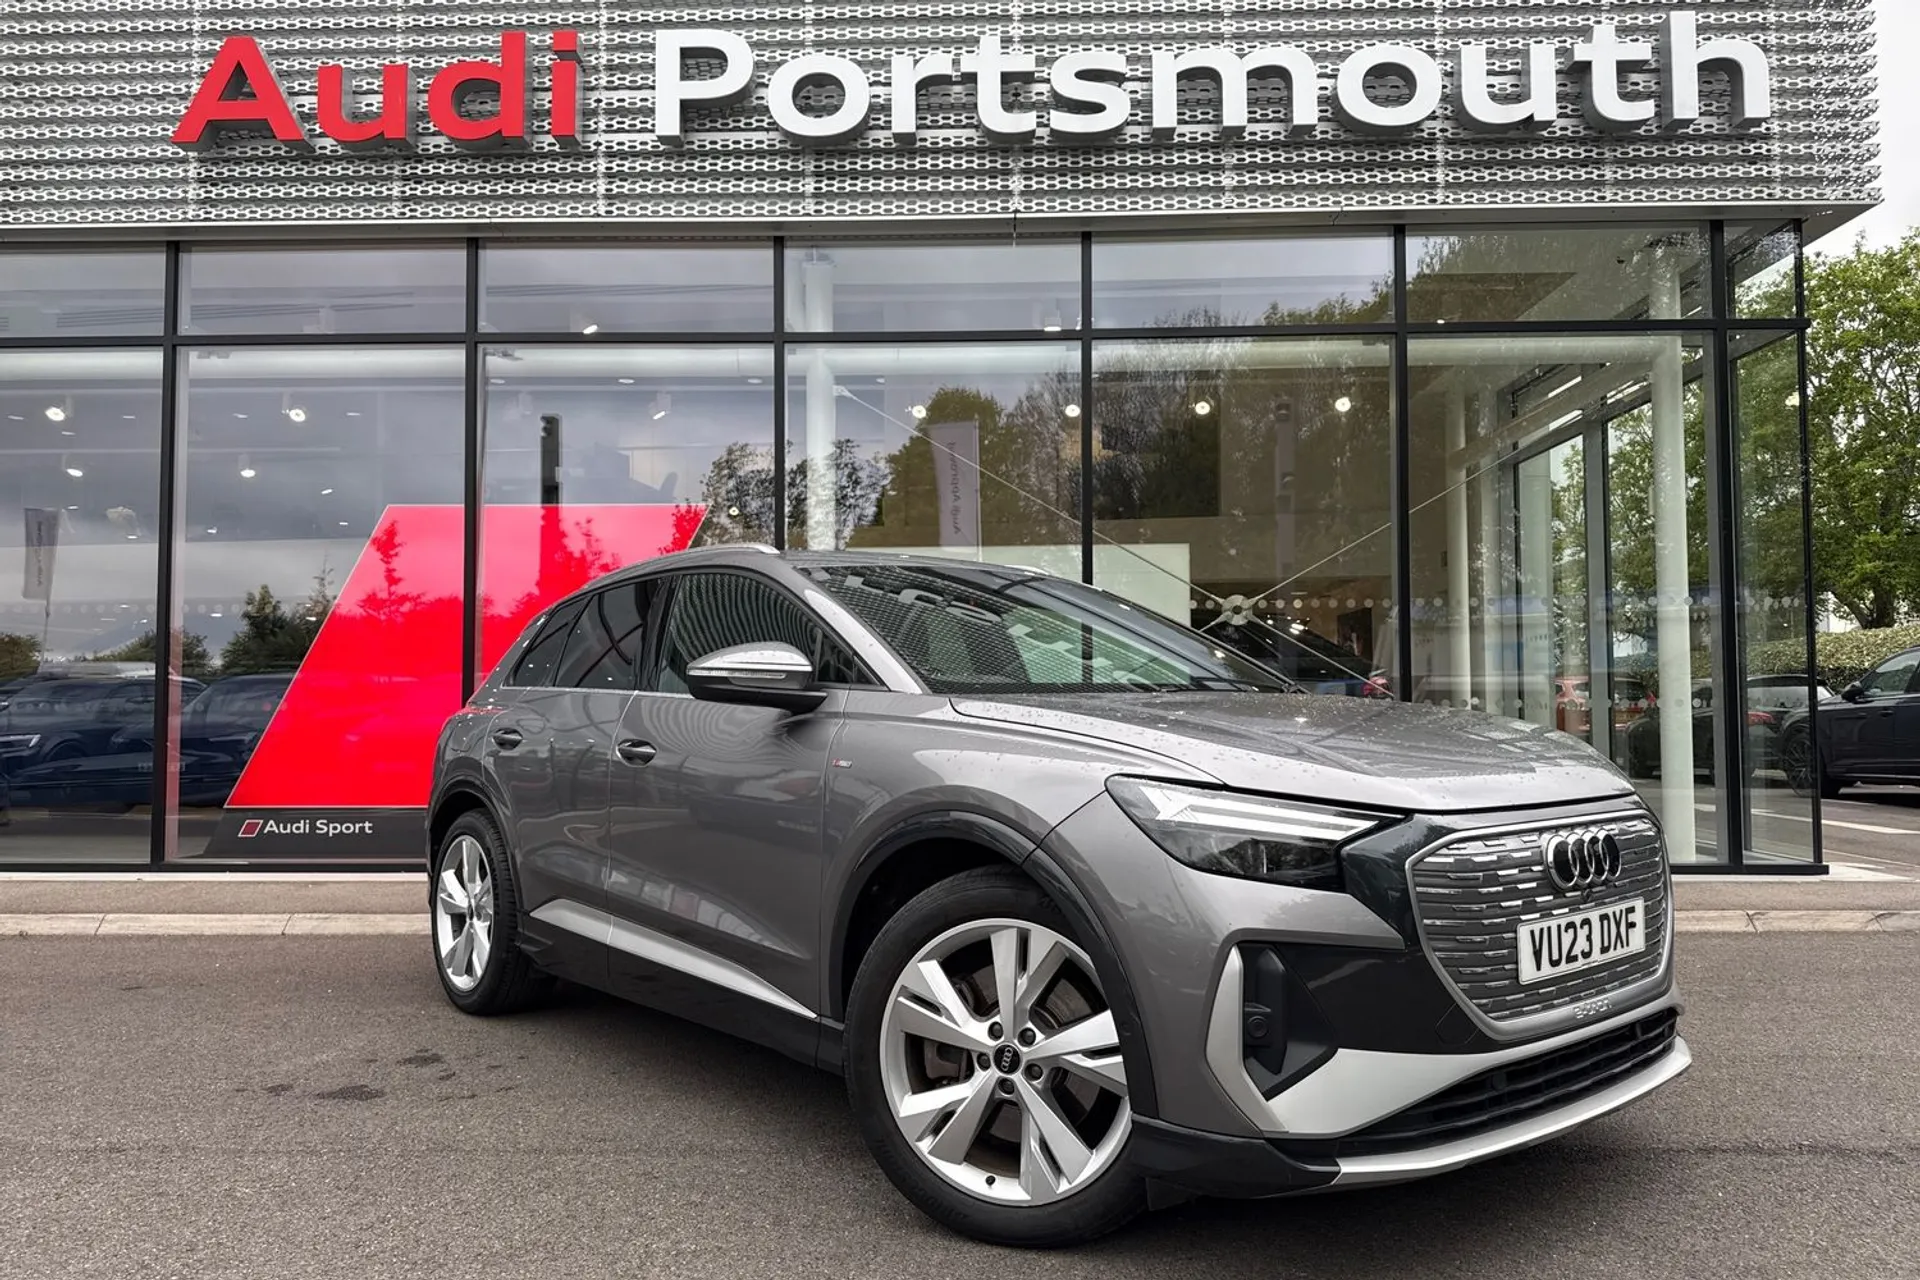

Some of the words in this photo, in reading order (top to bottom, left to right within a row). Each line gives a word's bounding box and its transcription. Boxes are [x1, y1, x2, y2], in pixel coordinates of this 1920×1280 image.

[171, 30, 580, 144] Audi
[655, 10, 1771, 138] Portsmouth
[263, 819, 310, 834] Audi
[315, 819, 373, 837] Sport
[1530, 917, 1593, 972] VU23
[1599, 906, 1637, 954] DXF
